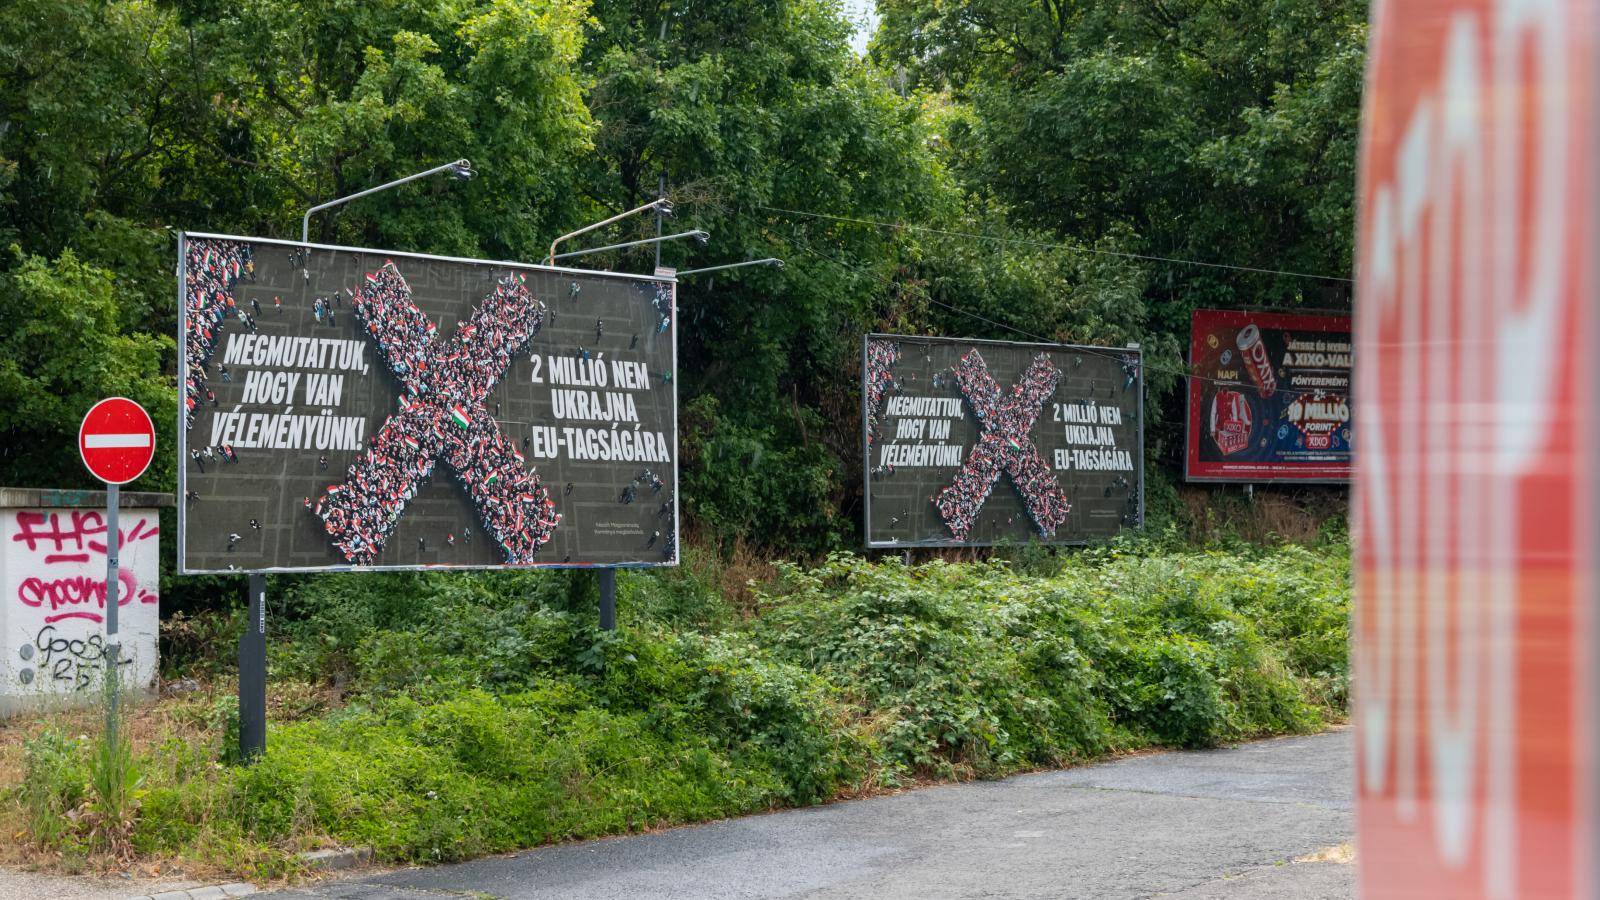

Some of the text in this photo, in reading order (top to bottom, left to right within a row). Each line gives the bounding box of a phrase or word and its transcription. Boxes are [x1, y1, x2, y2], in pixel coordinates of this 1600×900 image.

[223, 333, 369, 375] MEGMUTATTUK,
[1282, 352, 1293, 366] A
[530, 352, 650, 390] 2 MILLIÓ NEM
[1217, 370, 1238, 380] NAPI
[242, 371, 344, 406] HOGY VAN
[551, 388, 639, 422] UKRAJNA
[886, 396, 964, 420] MEGMUTATTUK,
[1053, 401, 1122, 425] 2 MILLIÓ NEM
[1304, 398, 1349, 422] MILLIÓ
[210, 404, 366, 451] VÉLEMÉNYÜNK!
[896, 418, 951, 440] HOGY VAN
[1065, 425, 1115, 446] UKRAJNA
[532, 422, 670, 462] EU-TAGSÁGÁRA
[880, 439, 963, 467] VÉLEMÉNYÜNK!
[1309, 436, 1329, 446] XIXO
[1054, 445, 1134, 471] EU-TAGSÁGÁRA
